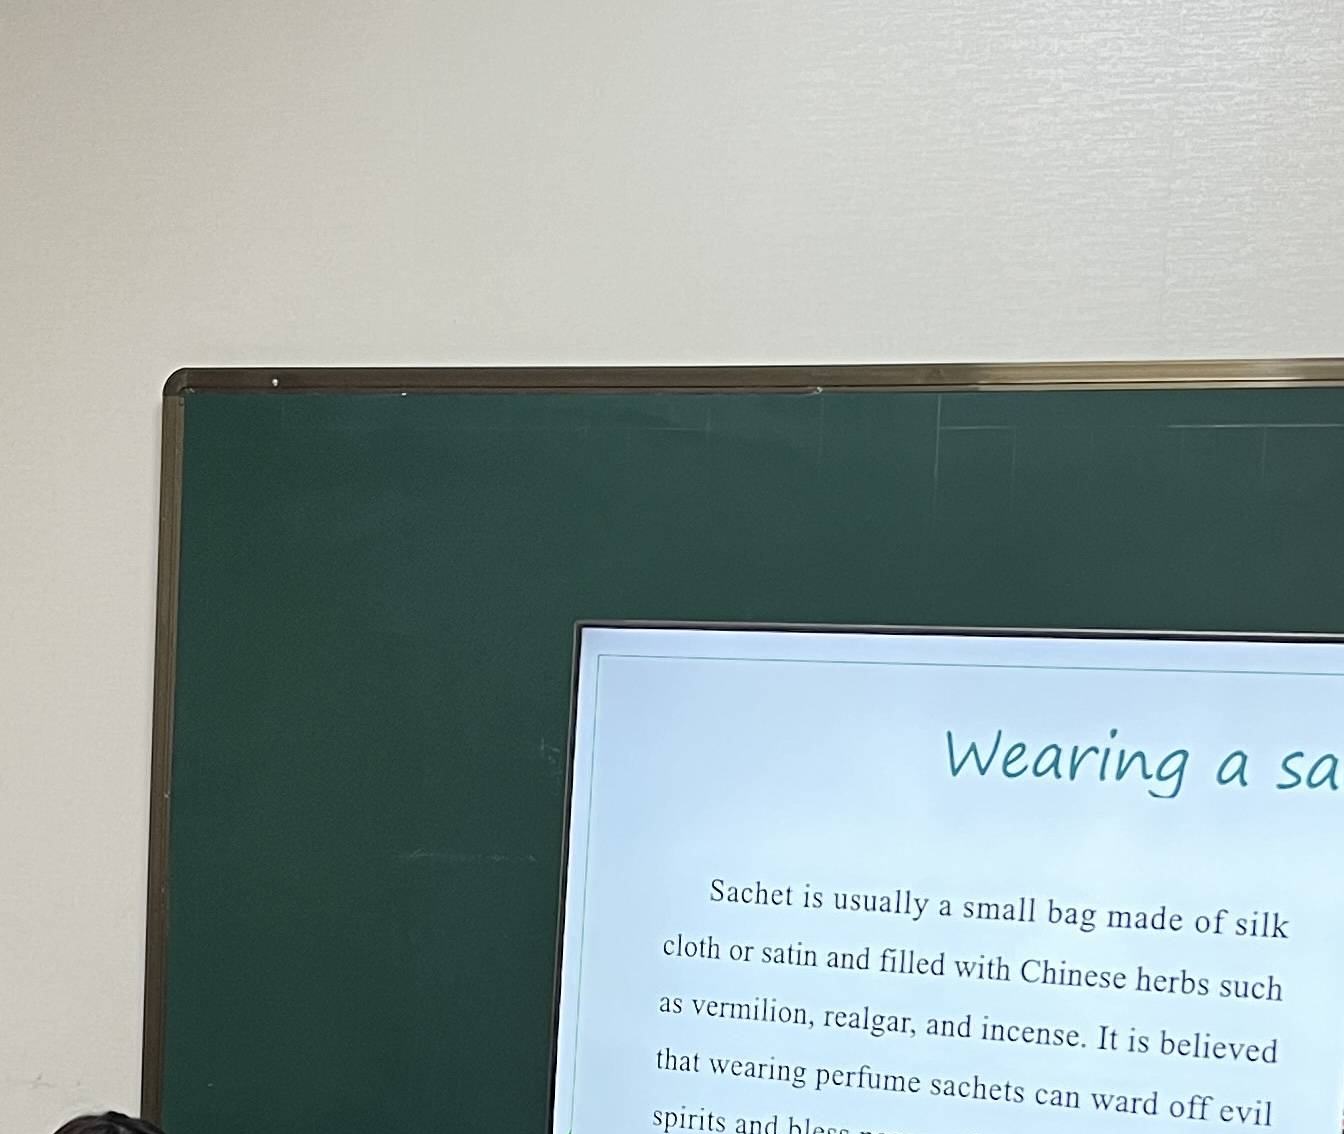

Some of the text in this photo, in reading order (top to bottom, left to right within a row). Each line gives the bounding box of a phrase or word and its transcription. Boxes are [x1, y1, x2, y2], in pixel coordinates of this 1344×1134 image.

[946, 728, 1190, 799] Wearing
[1216, 749, 1248, 787] a
[709, 878, 1290, 939] Sachet is usually a small bag made of silk
[663, 933, 1283, 1002] cloth or satin and filled with Chinese herbs such
[659, 996, 1278, 1064] as vermilion, realgar, and incense. It is believed
[652, 1105, 726, 1134] spirits
[656, 1047, 1272, 1127] that wearing perfume sachets can ward off evil
